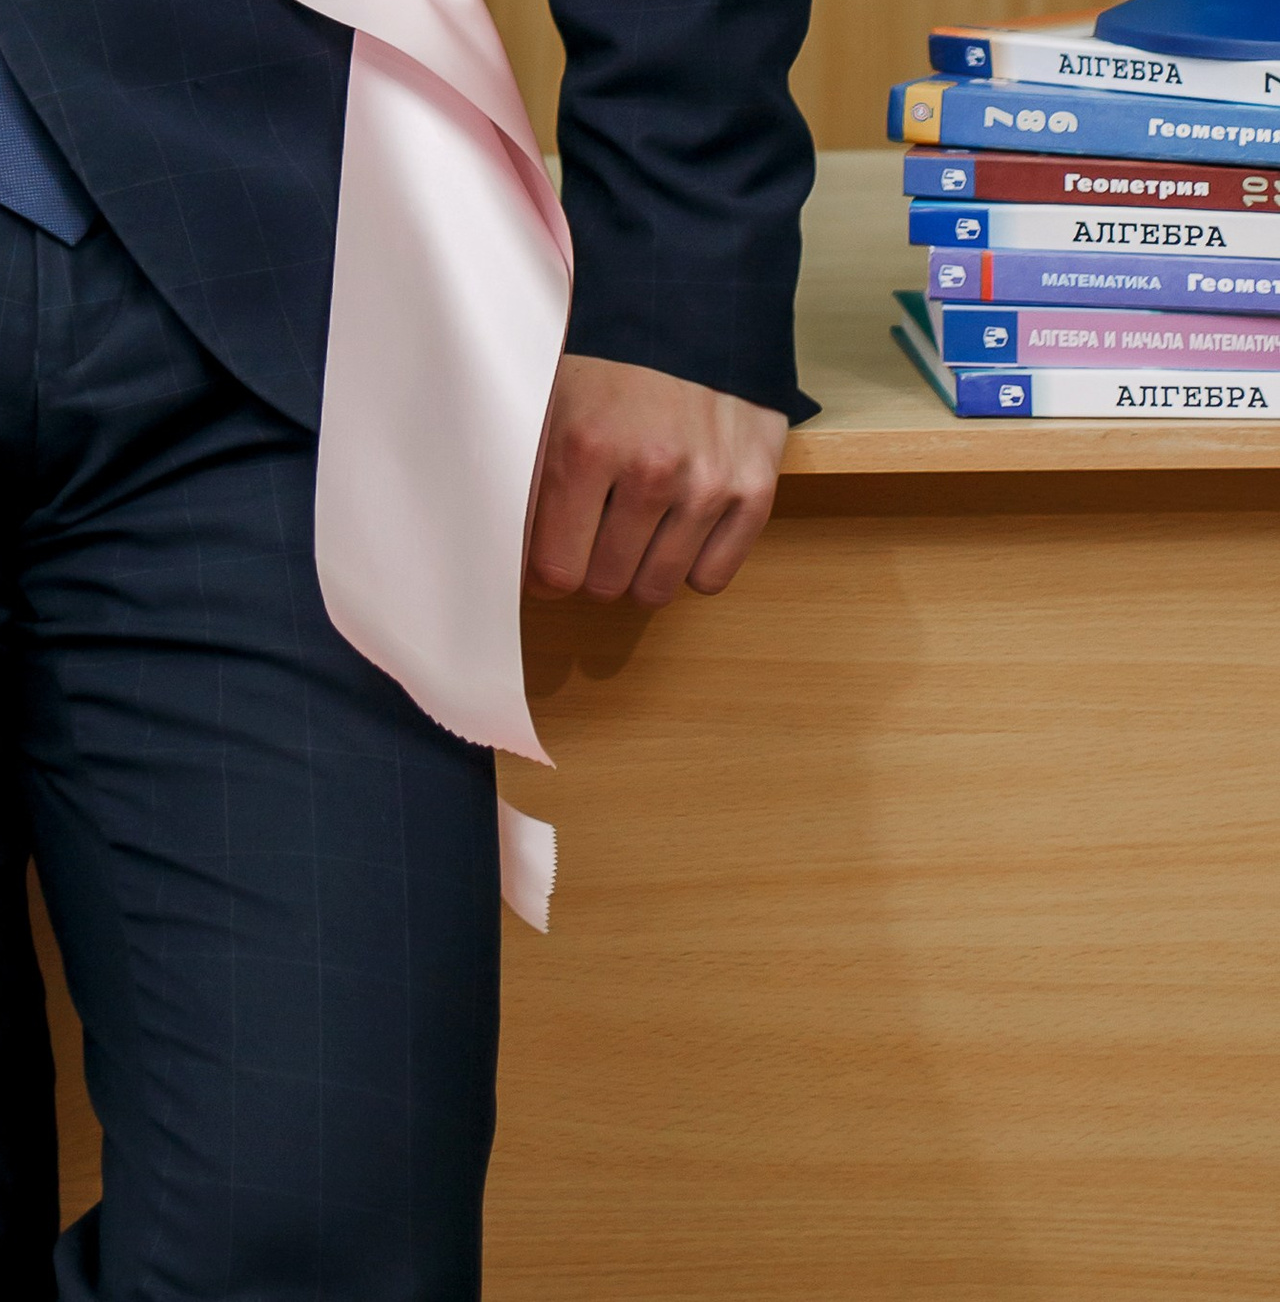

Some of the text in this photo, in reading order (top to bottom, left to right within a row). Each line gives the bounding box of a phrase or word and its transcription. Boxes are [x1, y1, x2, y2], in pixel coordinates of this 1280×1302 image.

[1058, 53, 1183, 85] АЛГЕБРА
[1147, 117, 1280, 147] Геометрия
[1064, 172, 1210, 201] Геометрия
[1242, 176, 1269, 208] 10
[1072, 221, 1228, 248] АЛГЕБРА
[1041, 272, 1162, 291] МАТЕМАТИКА
[1028, 329, 1100, 349] АЛГЕБРА
[1104, 330, 1117, 349] И
[1122, 331, 1185, 351] НАЧАЛА
[1116, 385, 1269, 408] АЛГЕБРА
